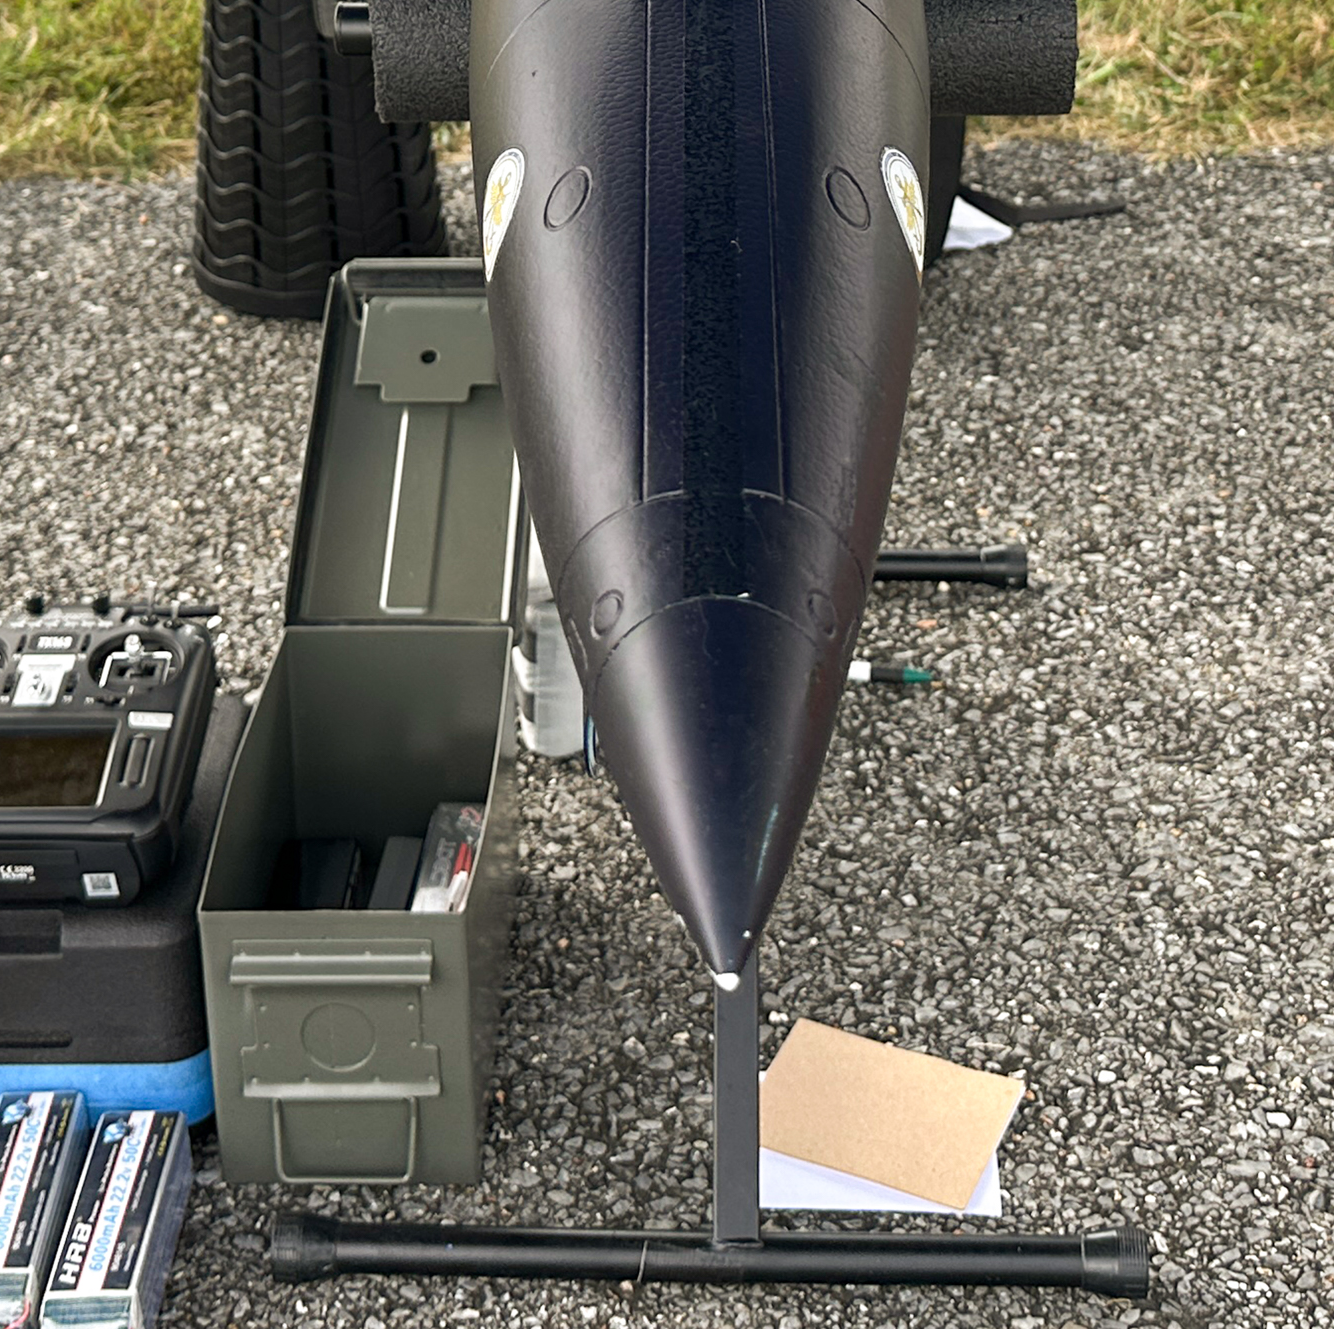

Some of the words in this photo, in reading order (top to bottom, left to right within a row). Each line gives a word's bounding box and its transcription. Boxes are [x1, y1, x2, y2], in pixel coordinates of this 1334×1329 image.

[11, 1147, 33, 1182] 22.2v
[22, 1118, 41, 1143] 50C
[89, 1205, 120, 1272] 6000mAh
[110, 1166, 132, 1206] 22.2v
[122, 1138, 142, 1163] 50C
[58, 1223, 92, 1285] HRB
